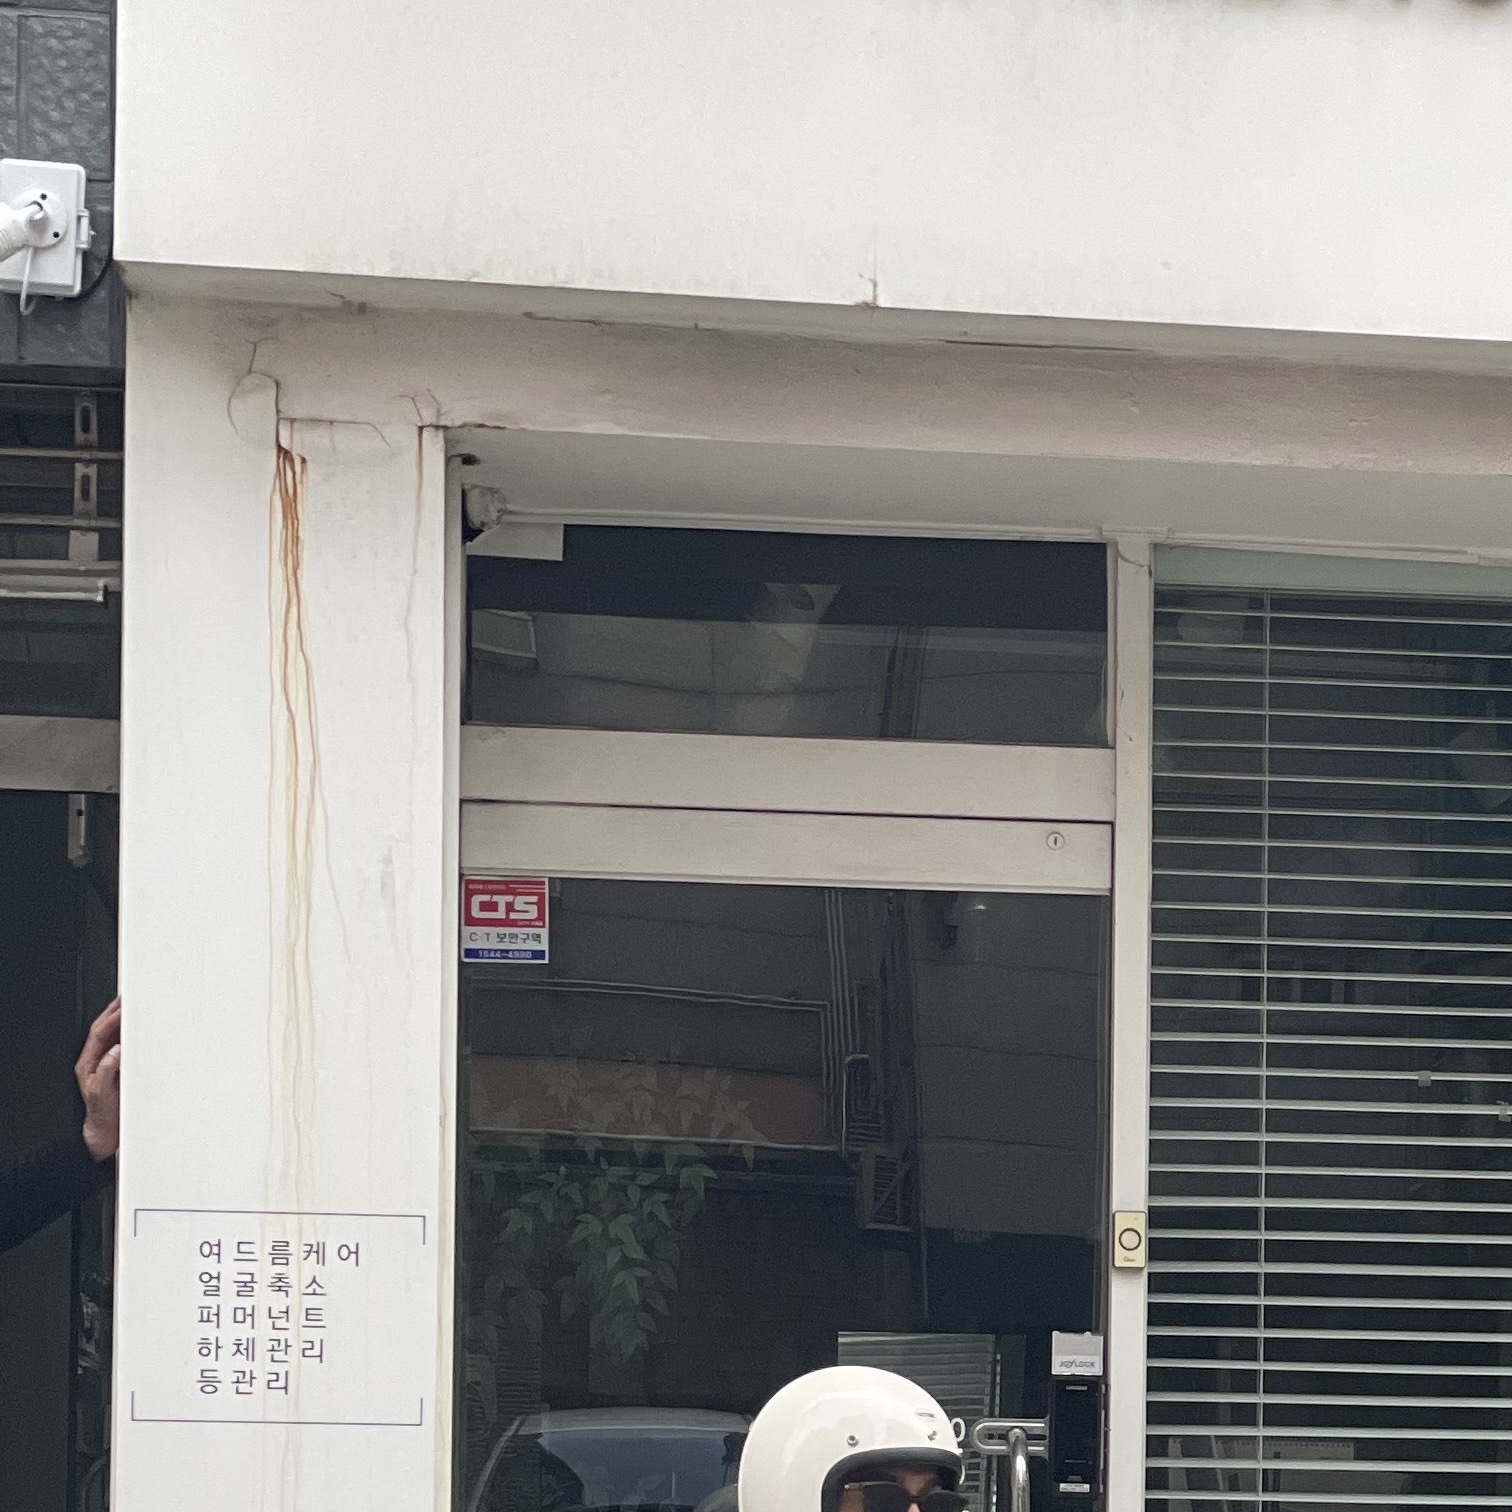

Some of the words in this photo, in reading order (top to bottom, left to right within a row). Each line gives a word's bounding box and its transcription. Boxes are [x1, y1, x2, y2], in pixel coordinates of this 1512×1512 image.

[470, 893, 539, 920] CTS
[200, 1240, 358, 1266] 여드름케어
[199, 1272, 325, 1297] 얼굴축소
[198, 1305, 325, 1330] 퍼머넌트
[198, 1337, 323, 1363] 하체관리
[198, 1370, 288, 1395] 등관리
